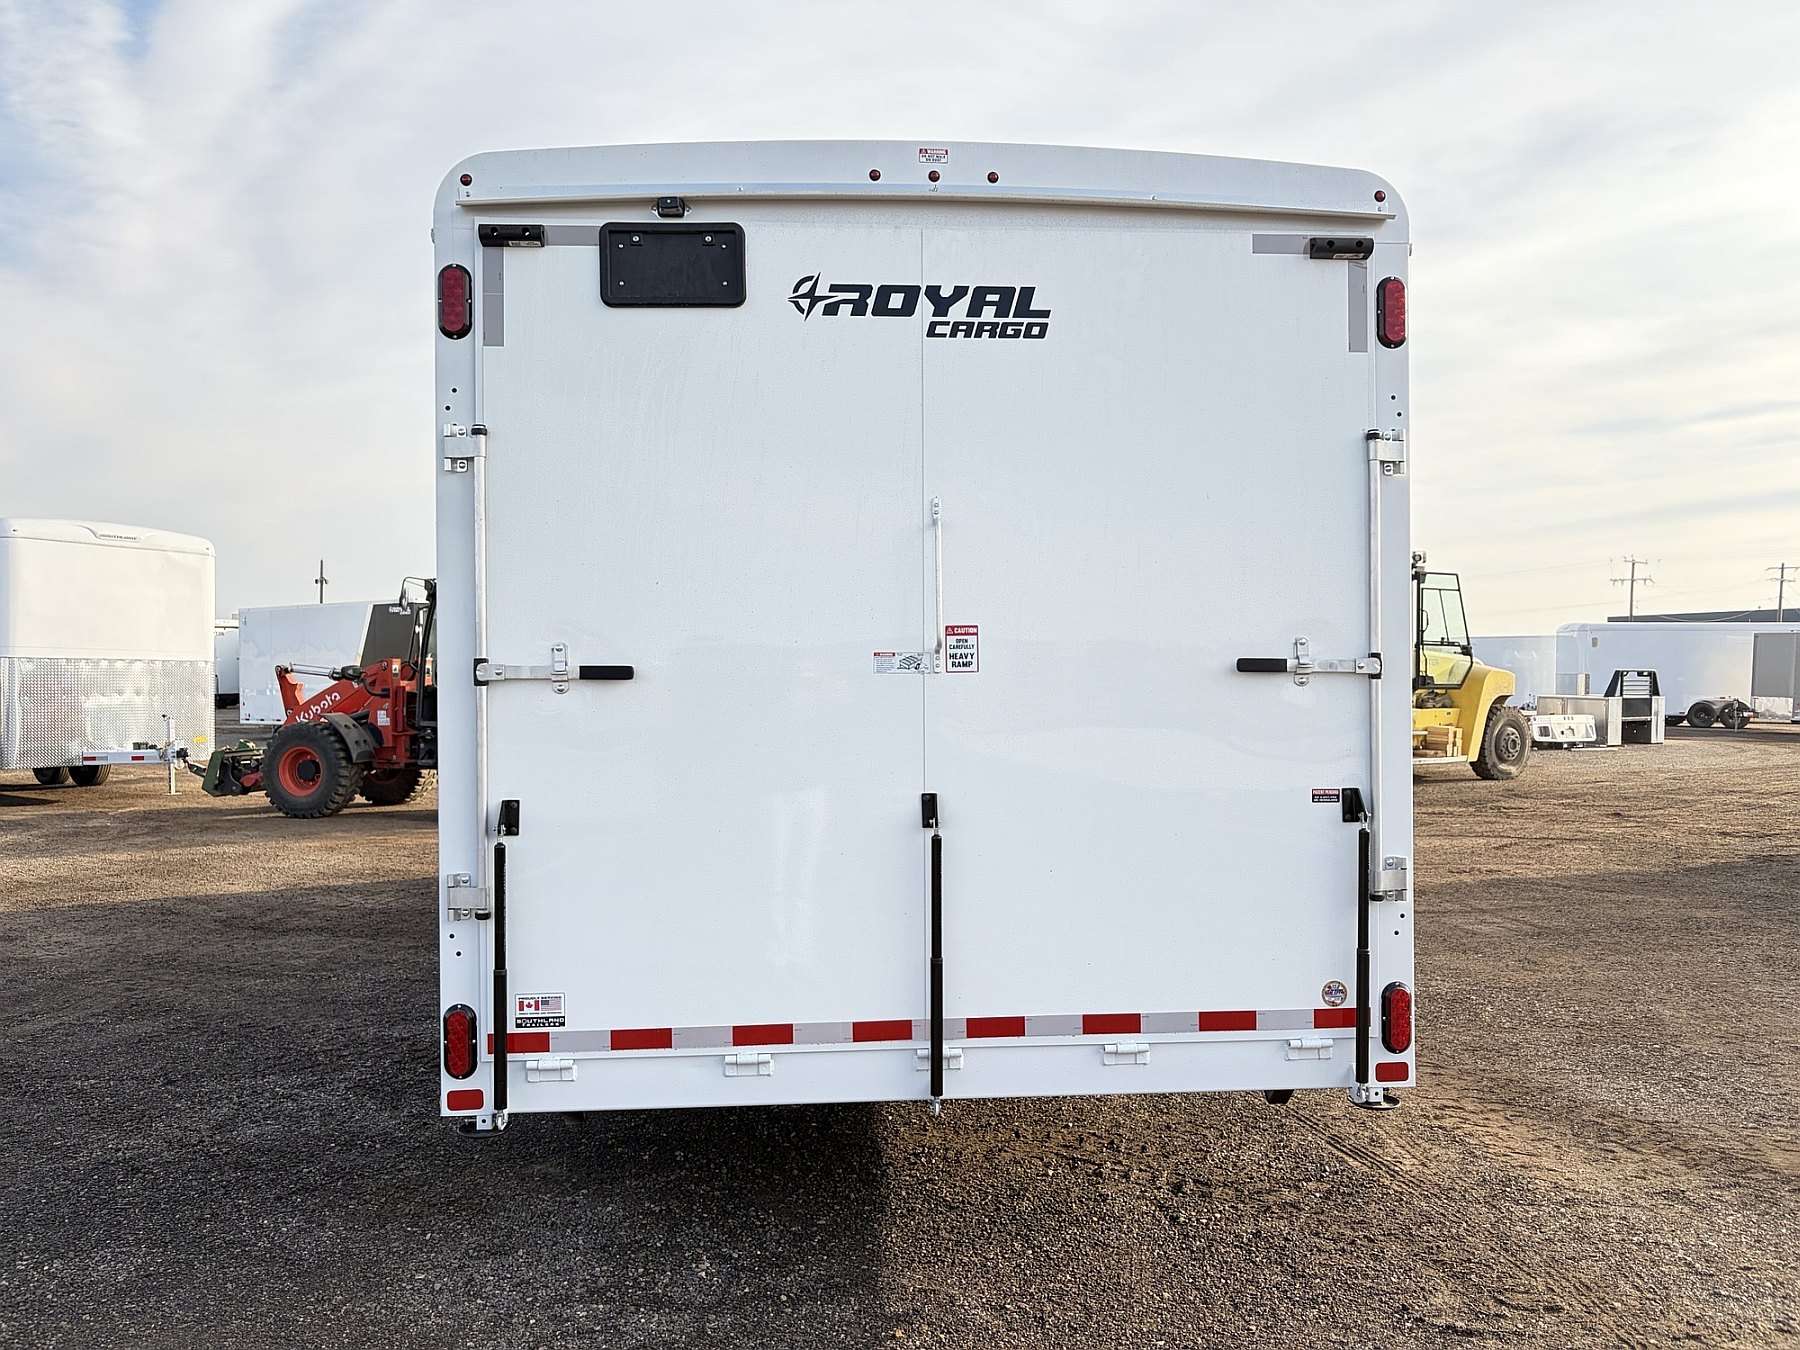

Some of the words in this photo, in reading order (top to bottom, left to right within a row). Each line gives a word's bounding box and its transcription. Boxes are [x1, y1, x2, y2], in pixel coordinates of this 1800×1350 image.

[822, 284, 1051, 319] ROYAL
[926, 321, 1049, 339] CARGO
[954, 626, 977, 635] CAUTION
[949, 652, 975, 660] HEAVY
[296, 692, 340, 722] Kubota
